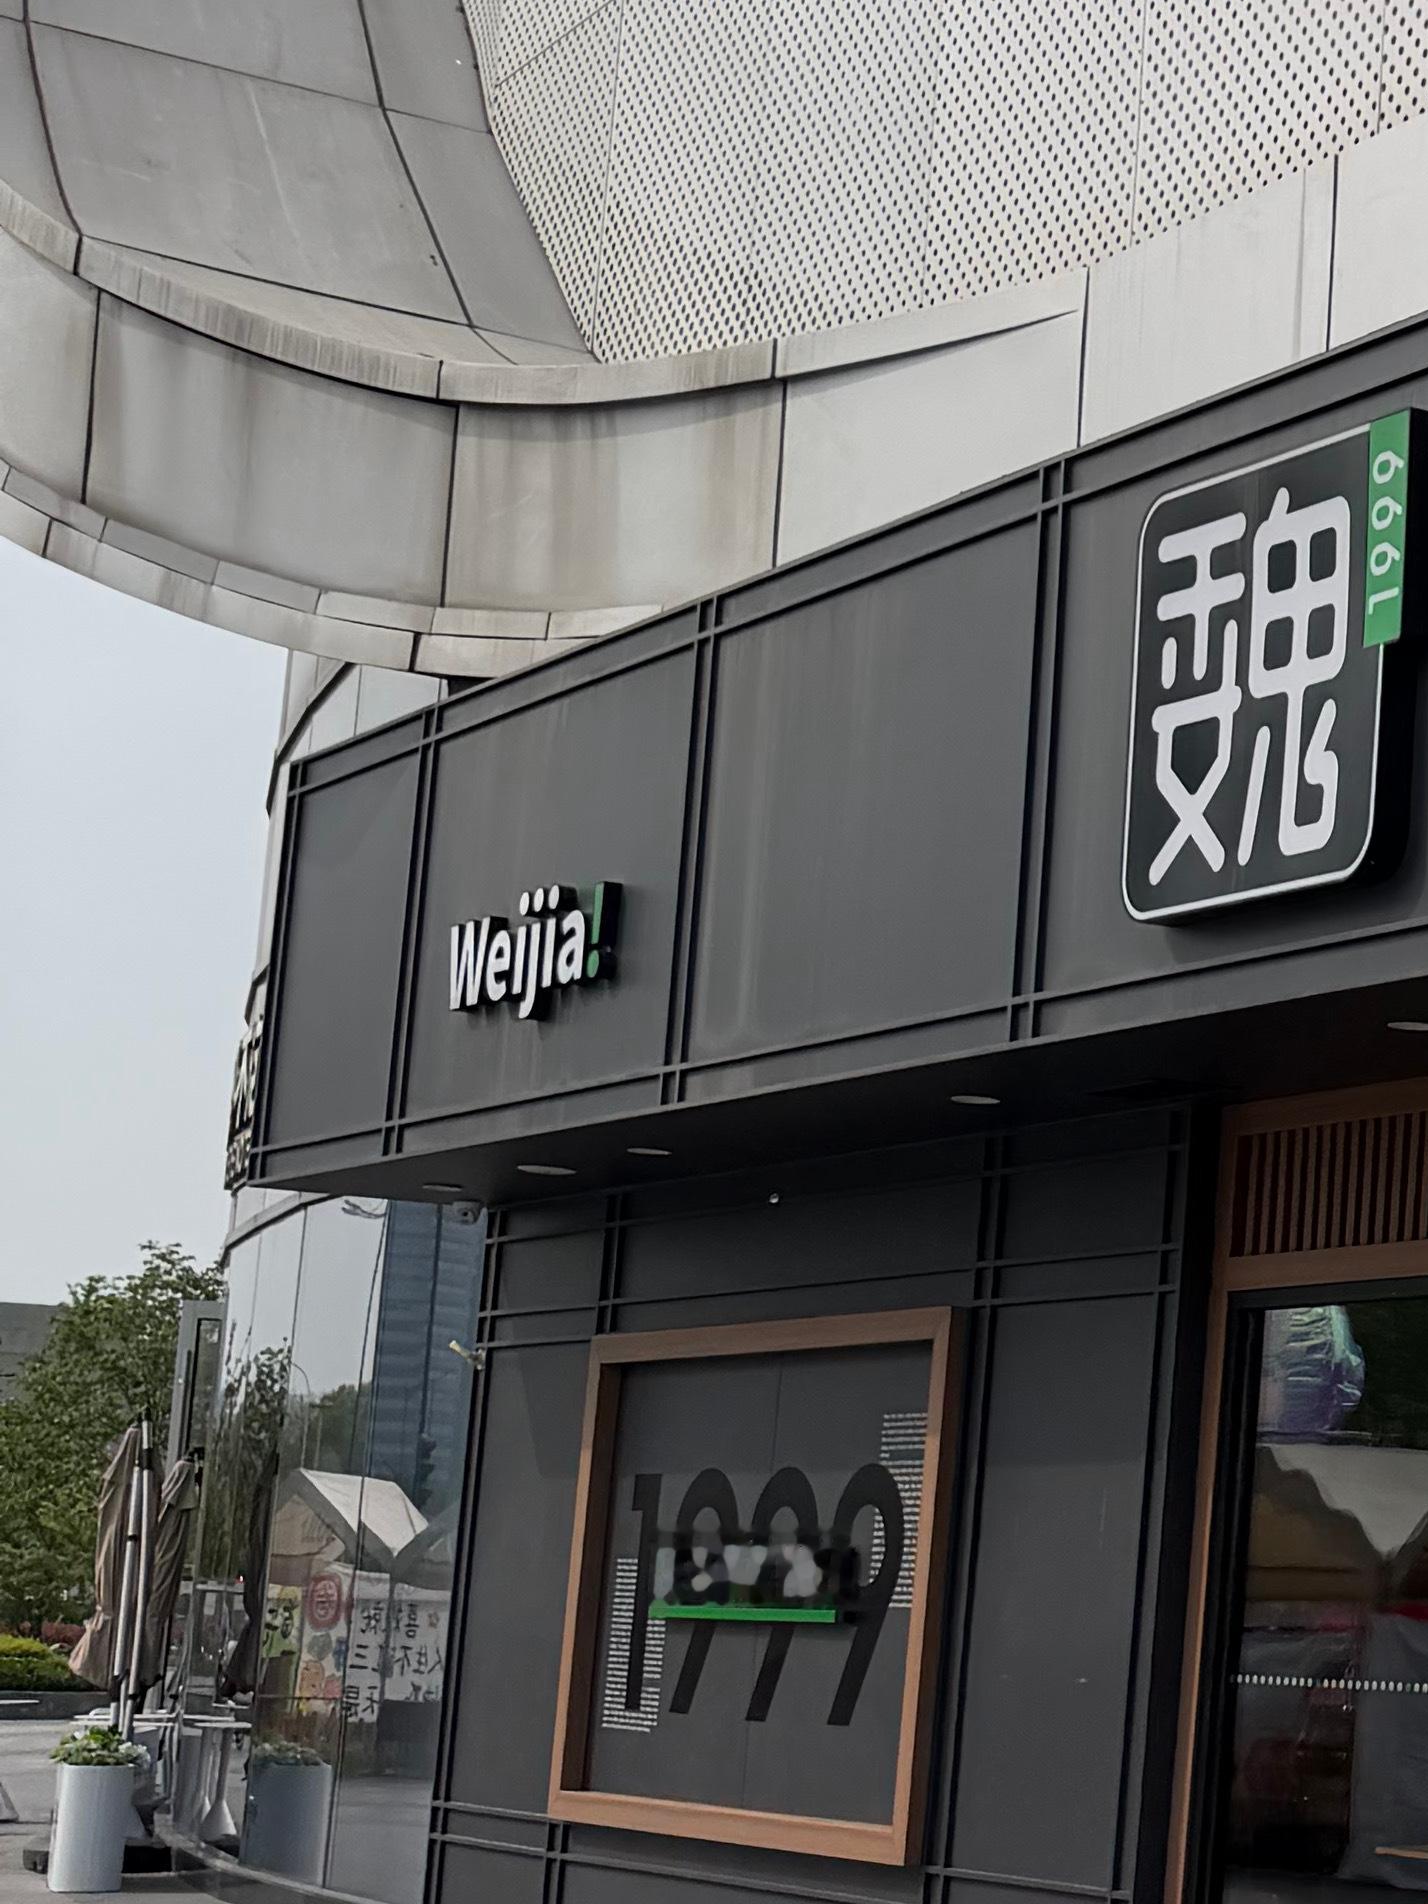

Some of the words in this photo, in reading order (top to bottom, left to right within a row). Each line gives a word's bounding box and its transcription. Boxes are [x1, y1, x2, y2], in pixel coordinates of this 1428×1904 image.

[1368, 449, 1405, 615] 1999
[1149, 487, 1351, 886] 魏
[449, 882, 604, 1020] Weijia!
